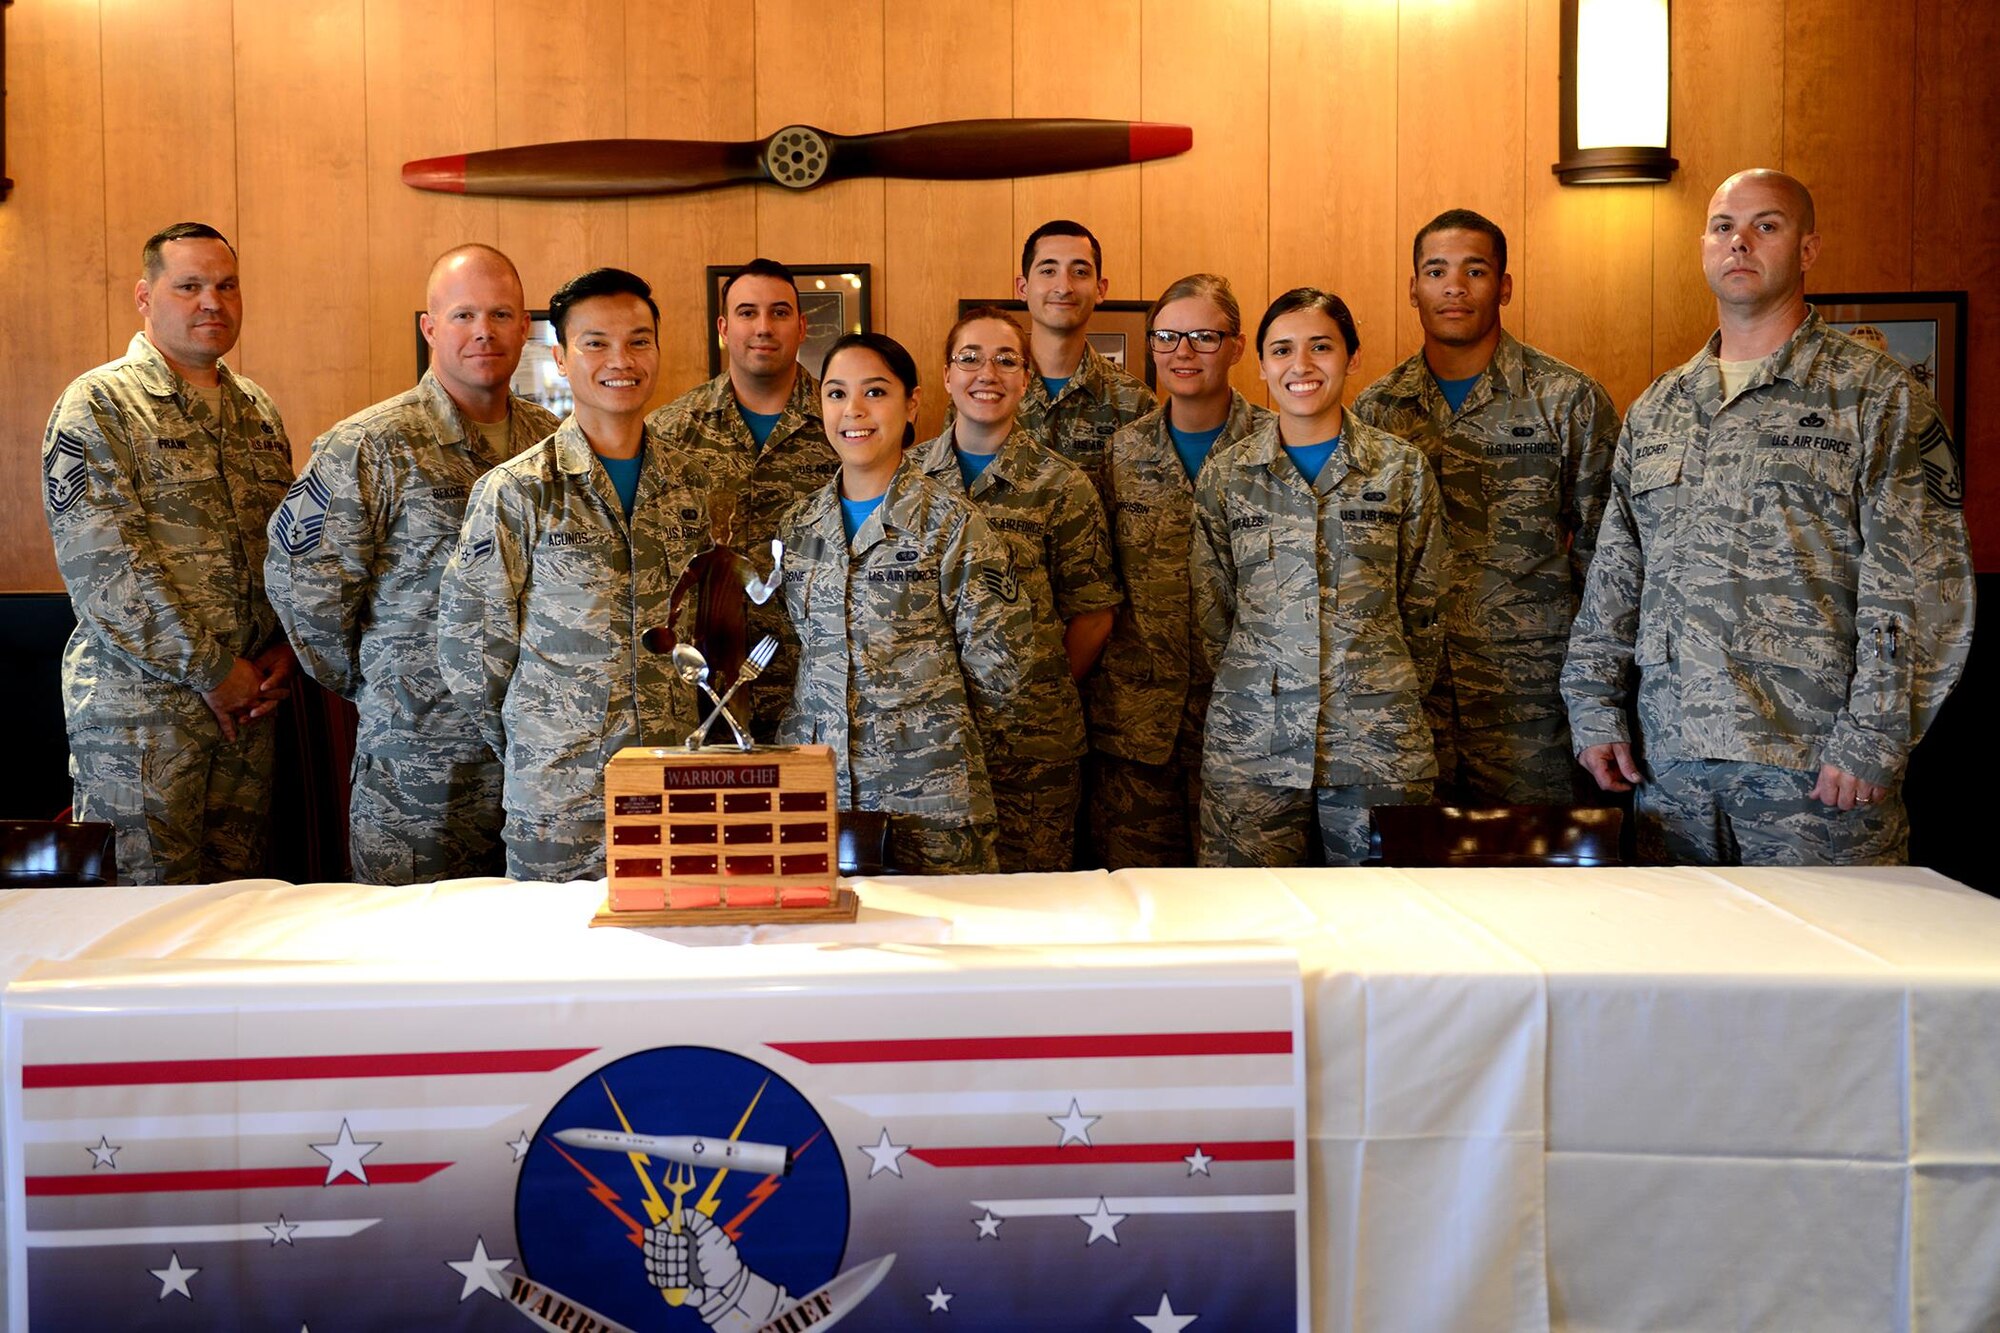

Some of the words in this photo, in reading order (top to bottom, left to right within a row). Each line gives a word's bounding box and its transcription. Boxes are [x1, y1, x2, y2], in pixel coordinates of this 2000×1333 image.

[157, 438, 188, 449] FRANK
[1506, 443, 1523, 455] AIR
[1524, 442, 1557, 454] FORCE
[1792, 435, 1812, 448] AIR
[1813, 437, 1852, 456] FORCE
[1360, 510, 1376, 521] AIR
[1015, 520, 1044, 534] FORCE
[548, 532, 589, 547] AGUNOS
[887, 570, 903, 582] AIR
[905, 570, 938, 582] FORCE
[667, 769, 736, 786] WARRIOR
[740, 768, 776, 785] CHEF
